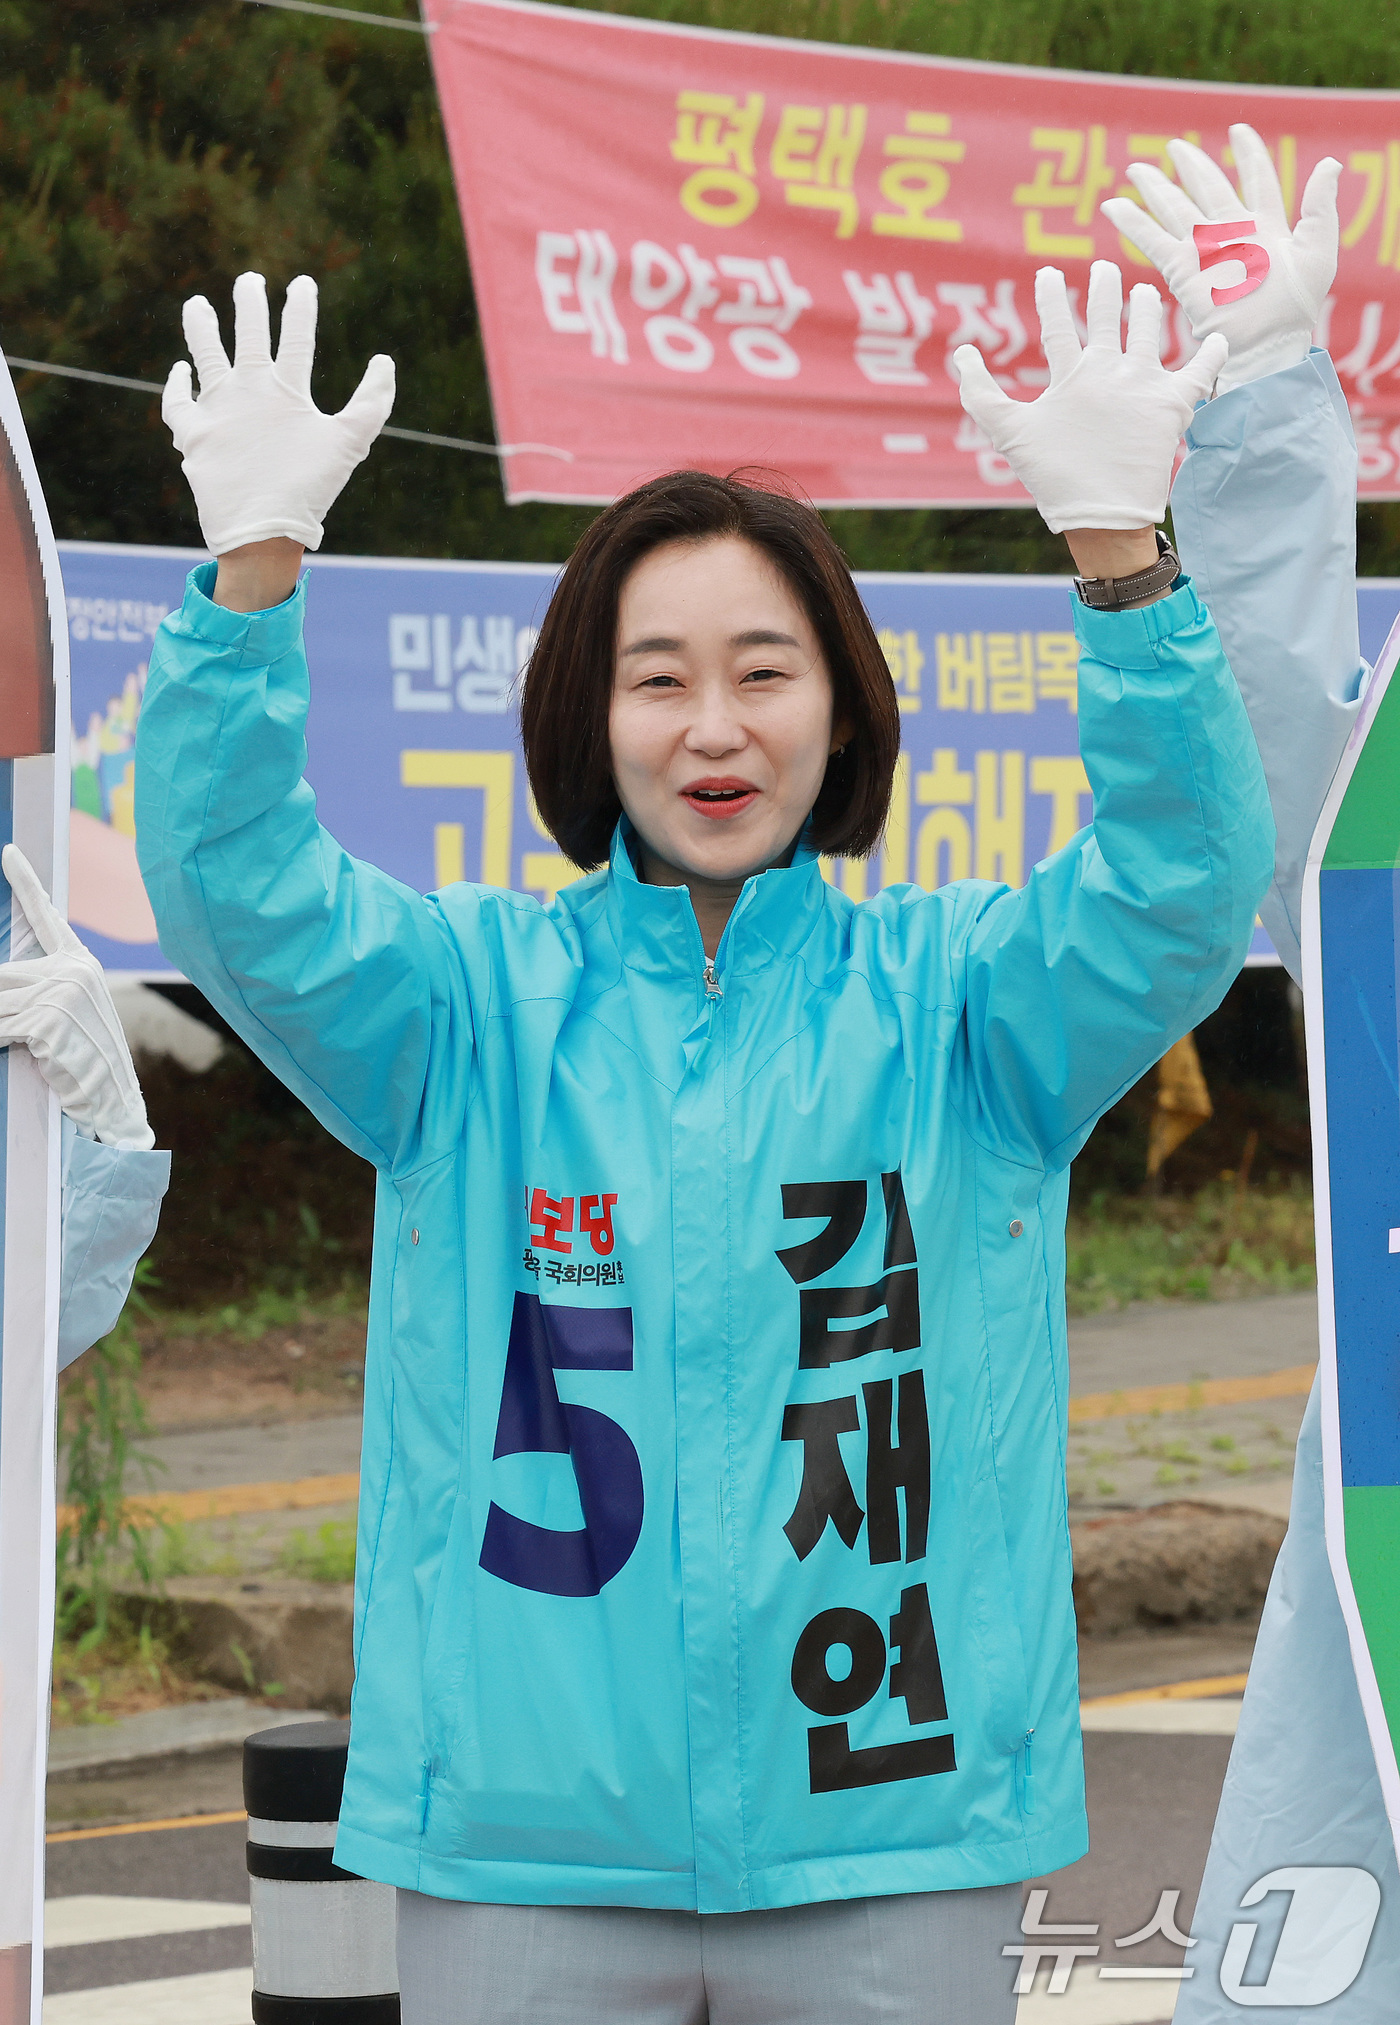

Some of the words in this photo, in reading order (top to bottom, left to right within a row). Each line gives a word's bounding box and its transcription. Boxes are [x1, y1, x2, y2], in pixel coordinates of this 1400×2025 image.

[669, 89, 966, 243] 평택호
[536, 229, 812, 379] 태양광
[1192, 220, 1271, 307] 5
[389, 614, 540, 714] 민생
[935, 631, 1081, 714] 버팀목
[525, 1185, 618, 1256] 보당
[479, 1290, 644, 1598] 5
[775, 1165, 957, 1794] 김재연
